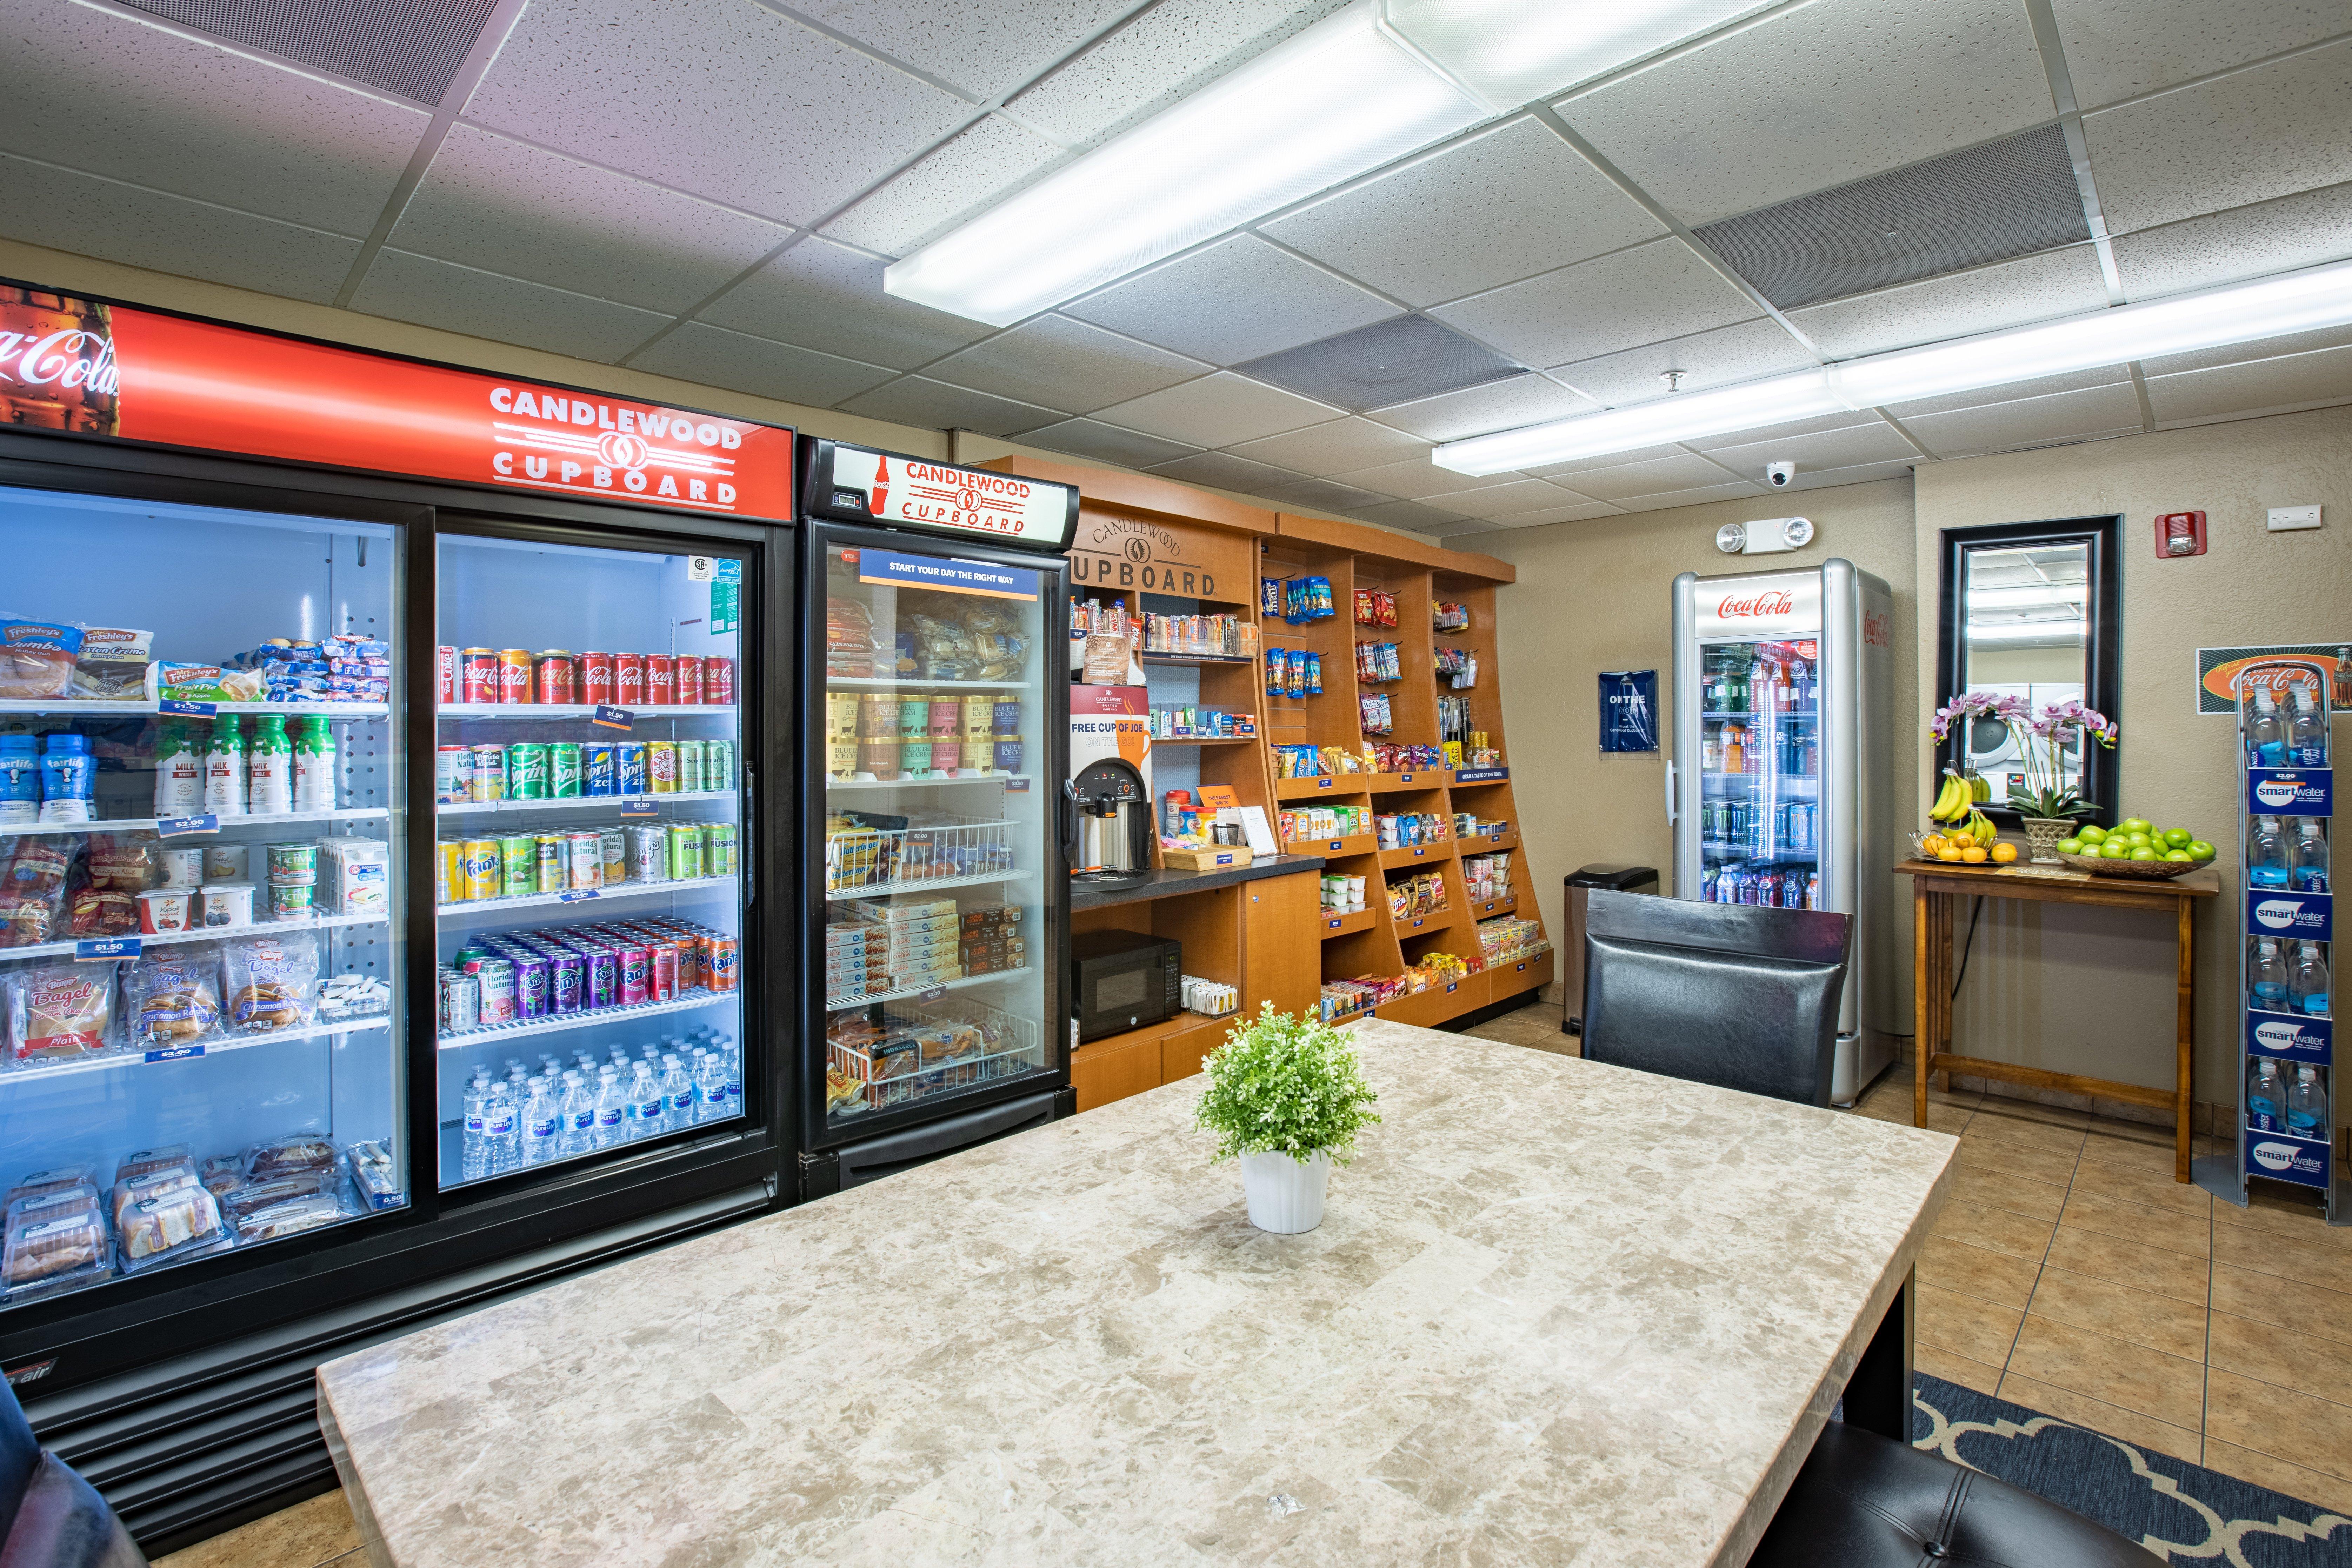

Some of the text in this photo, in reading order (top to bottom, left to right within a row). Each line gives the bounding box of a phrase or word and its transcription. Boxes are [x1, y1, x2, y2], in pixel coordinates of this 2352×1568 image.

[0, 329, 119, 396] a-Cola
[490, 388, 741, 449] CANDLEWOOD
[493, 452, 736, 503] CUPBOARD
[906, 463, 1030, 498] CANDLEWOOD
[874, 480, 889, 489] Coca-Cola
[902, 502, 1024, 532] CUPBOARD
[1093, 519, 1180, 556] CANDLEWOOD
[890, 562, 1013, 585] START YOUR DAY THE RIGHT WAY
[1074, 556, 1214, 595] UPBOARD
[1718, 590, 1794, 619] Coca-Cola
[86, 632, 133, 641] Freshley's
[7, 641, 62, 652] Jumbo
[111, 647, 145, 655] Creme
[441, 653, 453, 681] Coke
[2216, 661, 2239, 673] Refresh
[169, 669, 218, 680] Freshley's
[1623, 695, 1645, 703] THE
[1072, 723, 1143, 733] FREE CUP OF JOE
[1086, 737, 1134, 747] ON THE GO!
[0, 759, 34, 769] airlife
[47, 758, 84, 768] fairlife
[512, 763, 547, 785] Sprite
[583, 760, 614, 781] Sprite
[175, 819, 204, 827] $2.00
[572, 840, 597, 848] Florida's
[841, 841, 879, 855] Butterfinger
[20, 849, 36, 858] Otis
[90, 856, 104, 864] Otis
[284, 856, 312, 864] ACTIVIA
[466, 856, 499, 877] Fanta
[832, 865, 870, 879] Butterfinger
[282, 893, 311, 901] ACTIVIA
[248, 960, 294, 973] Bagel
[711, 953, 737, 971] Fanta
[48, 979, 76, 989] BURRY
[32, 982, 92, 1007] Bagel
[243, 1002, 282, 1012] Cinnamon
[35, 1011, 61, 1020] Cream
[141, 1011, 181, 1021] Cinnamon
[51, 1034, 80, 1045] Plain
[2261, 1114, 2270, 1130] water
[20, 1367, 49, 1383] air
